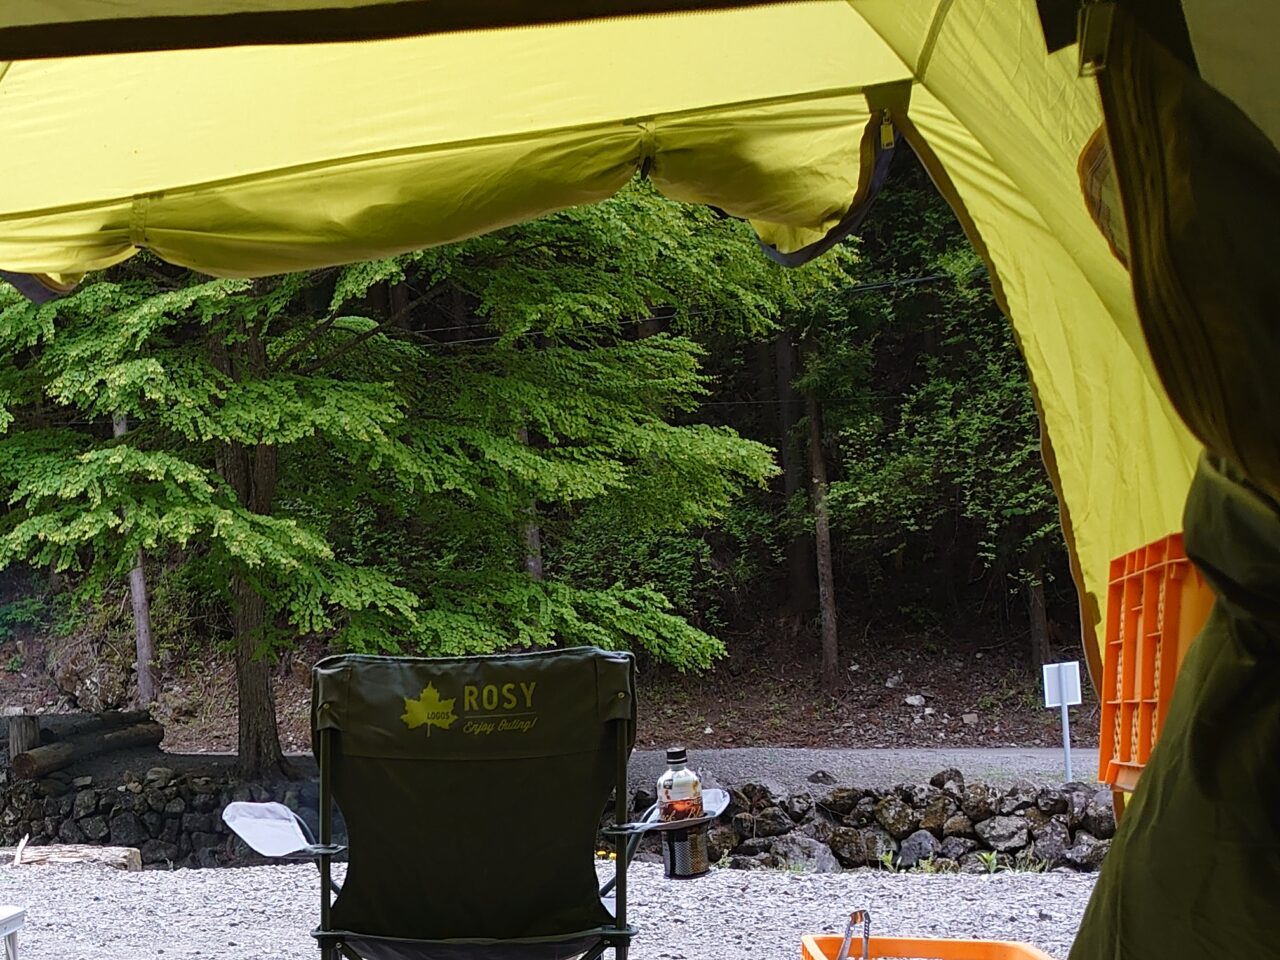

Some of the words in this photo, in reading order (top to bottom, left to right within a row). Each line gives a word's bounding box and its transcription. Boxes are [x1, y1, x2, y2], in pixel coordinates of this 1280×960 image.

[463, 681, 537, 712] ROSY
[427, 711, 450, 720] LOGOS
[463, 720, 496, 736] Enjoy
[497, 717, 538, 733] Outing!
